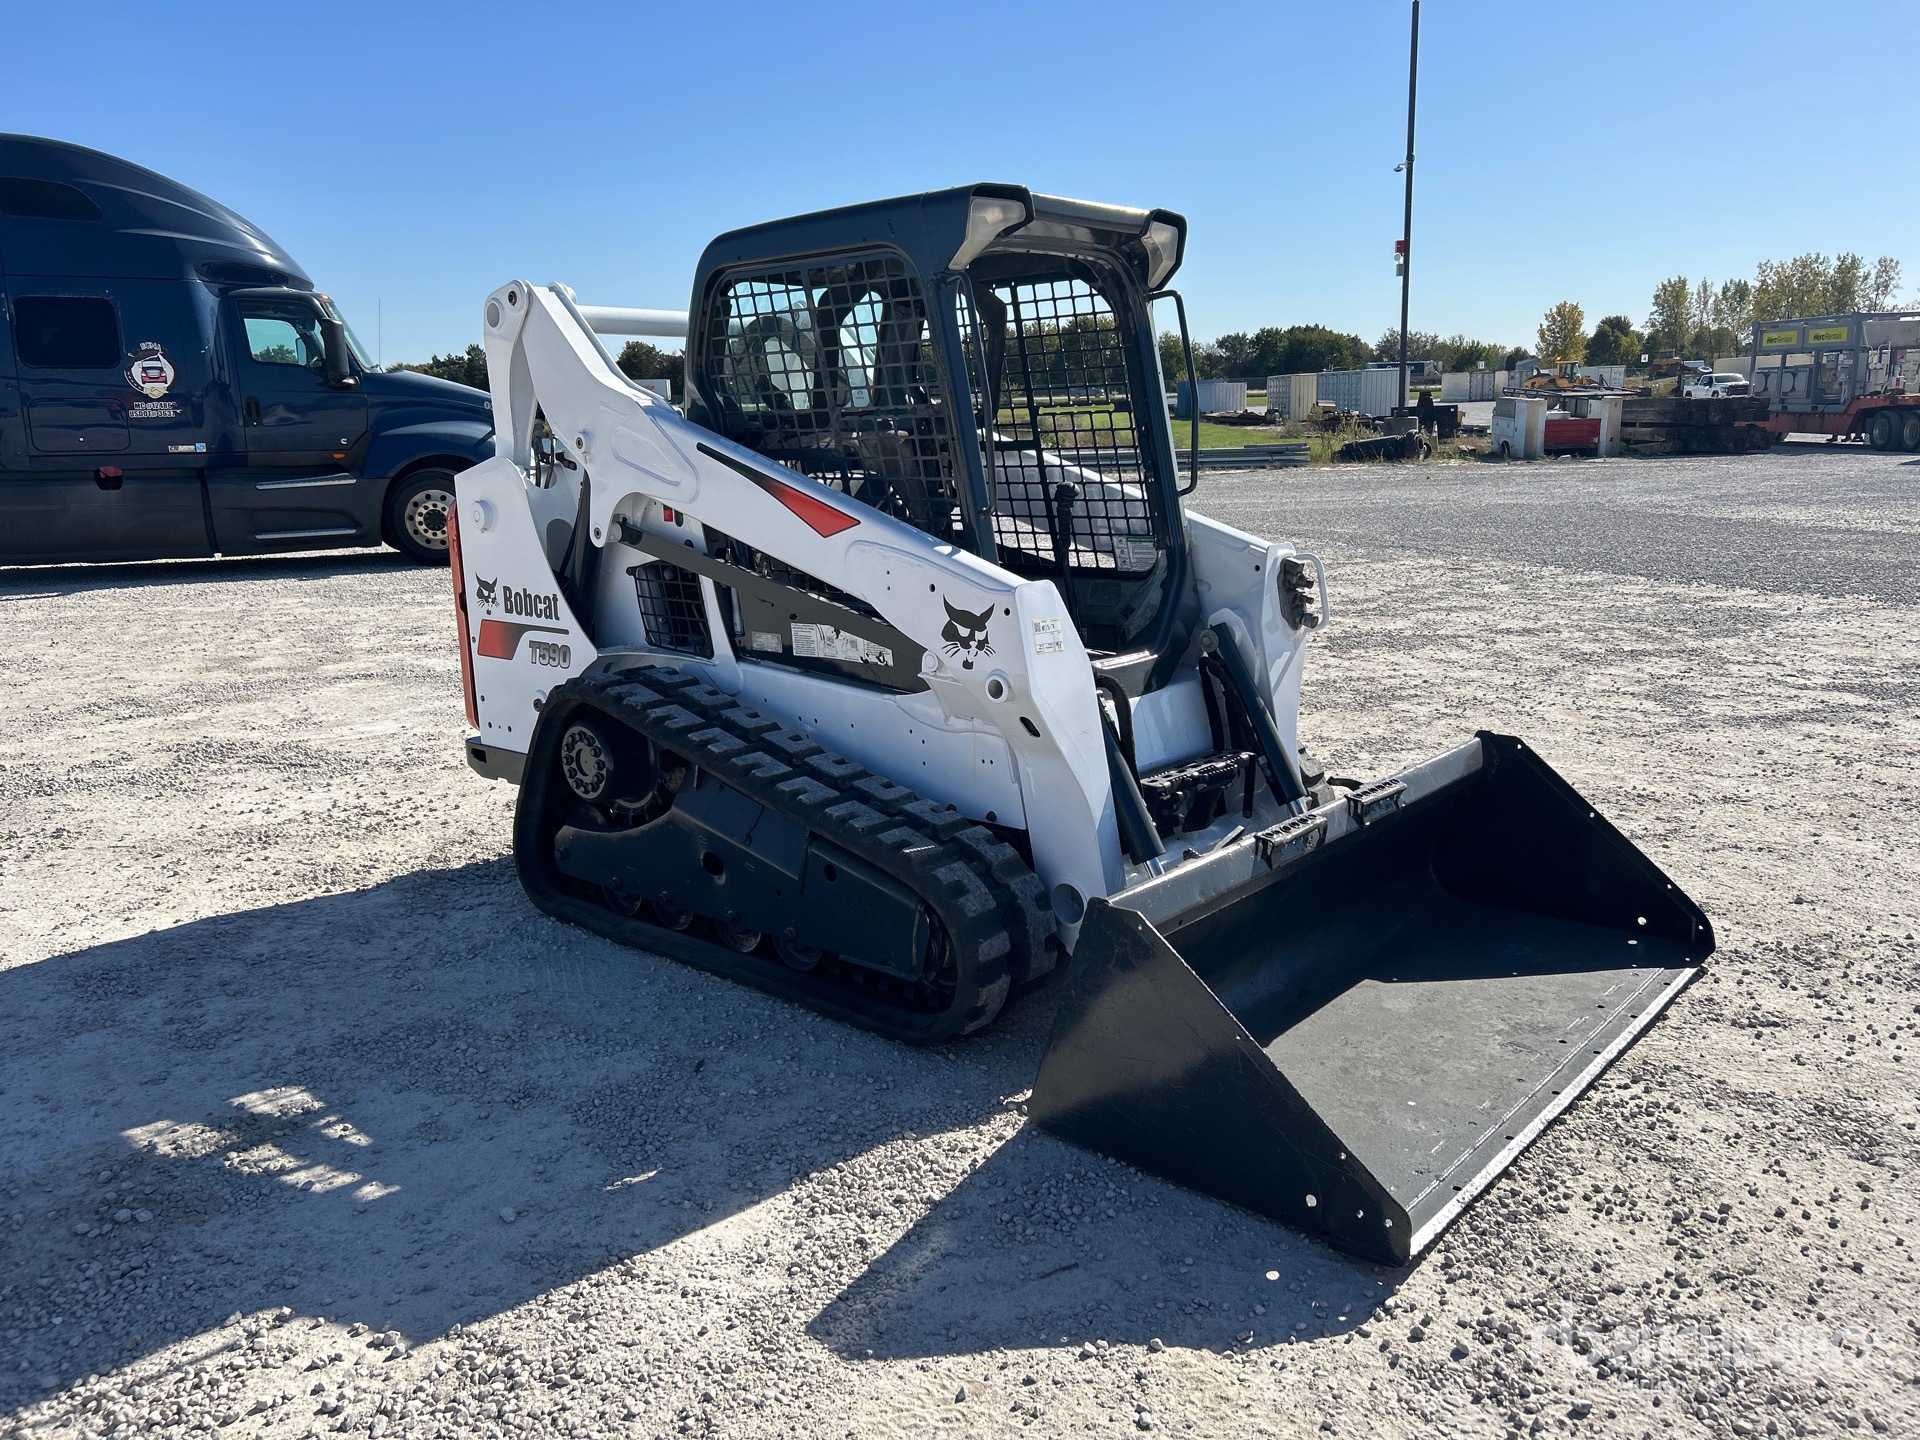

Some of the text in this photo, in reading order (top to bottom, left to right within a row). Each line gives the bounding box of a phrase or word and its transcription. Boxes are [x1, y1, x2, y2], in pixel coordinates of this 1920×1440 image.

[1812, 331, 1845, 342] HercRentals
[133, 402, 146, 410] MC
[128, 410, 157, 418] USDOT#
[502, 585, 560, 621] Bobcat
[528, 640, 571, 670] T590
